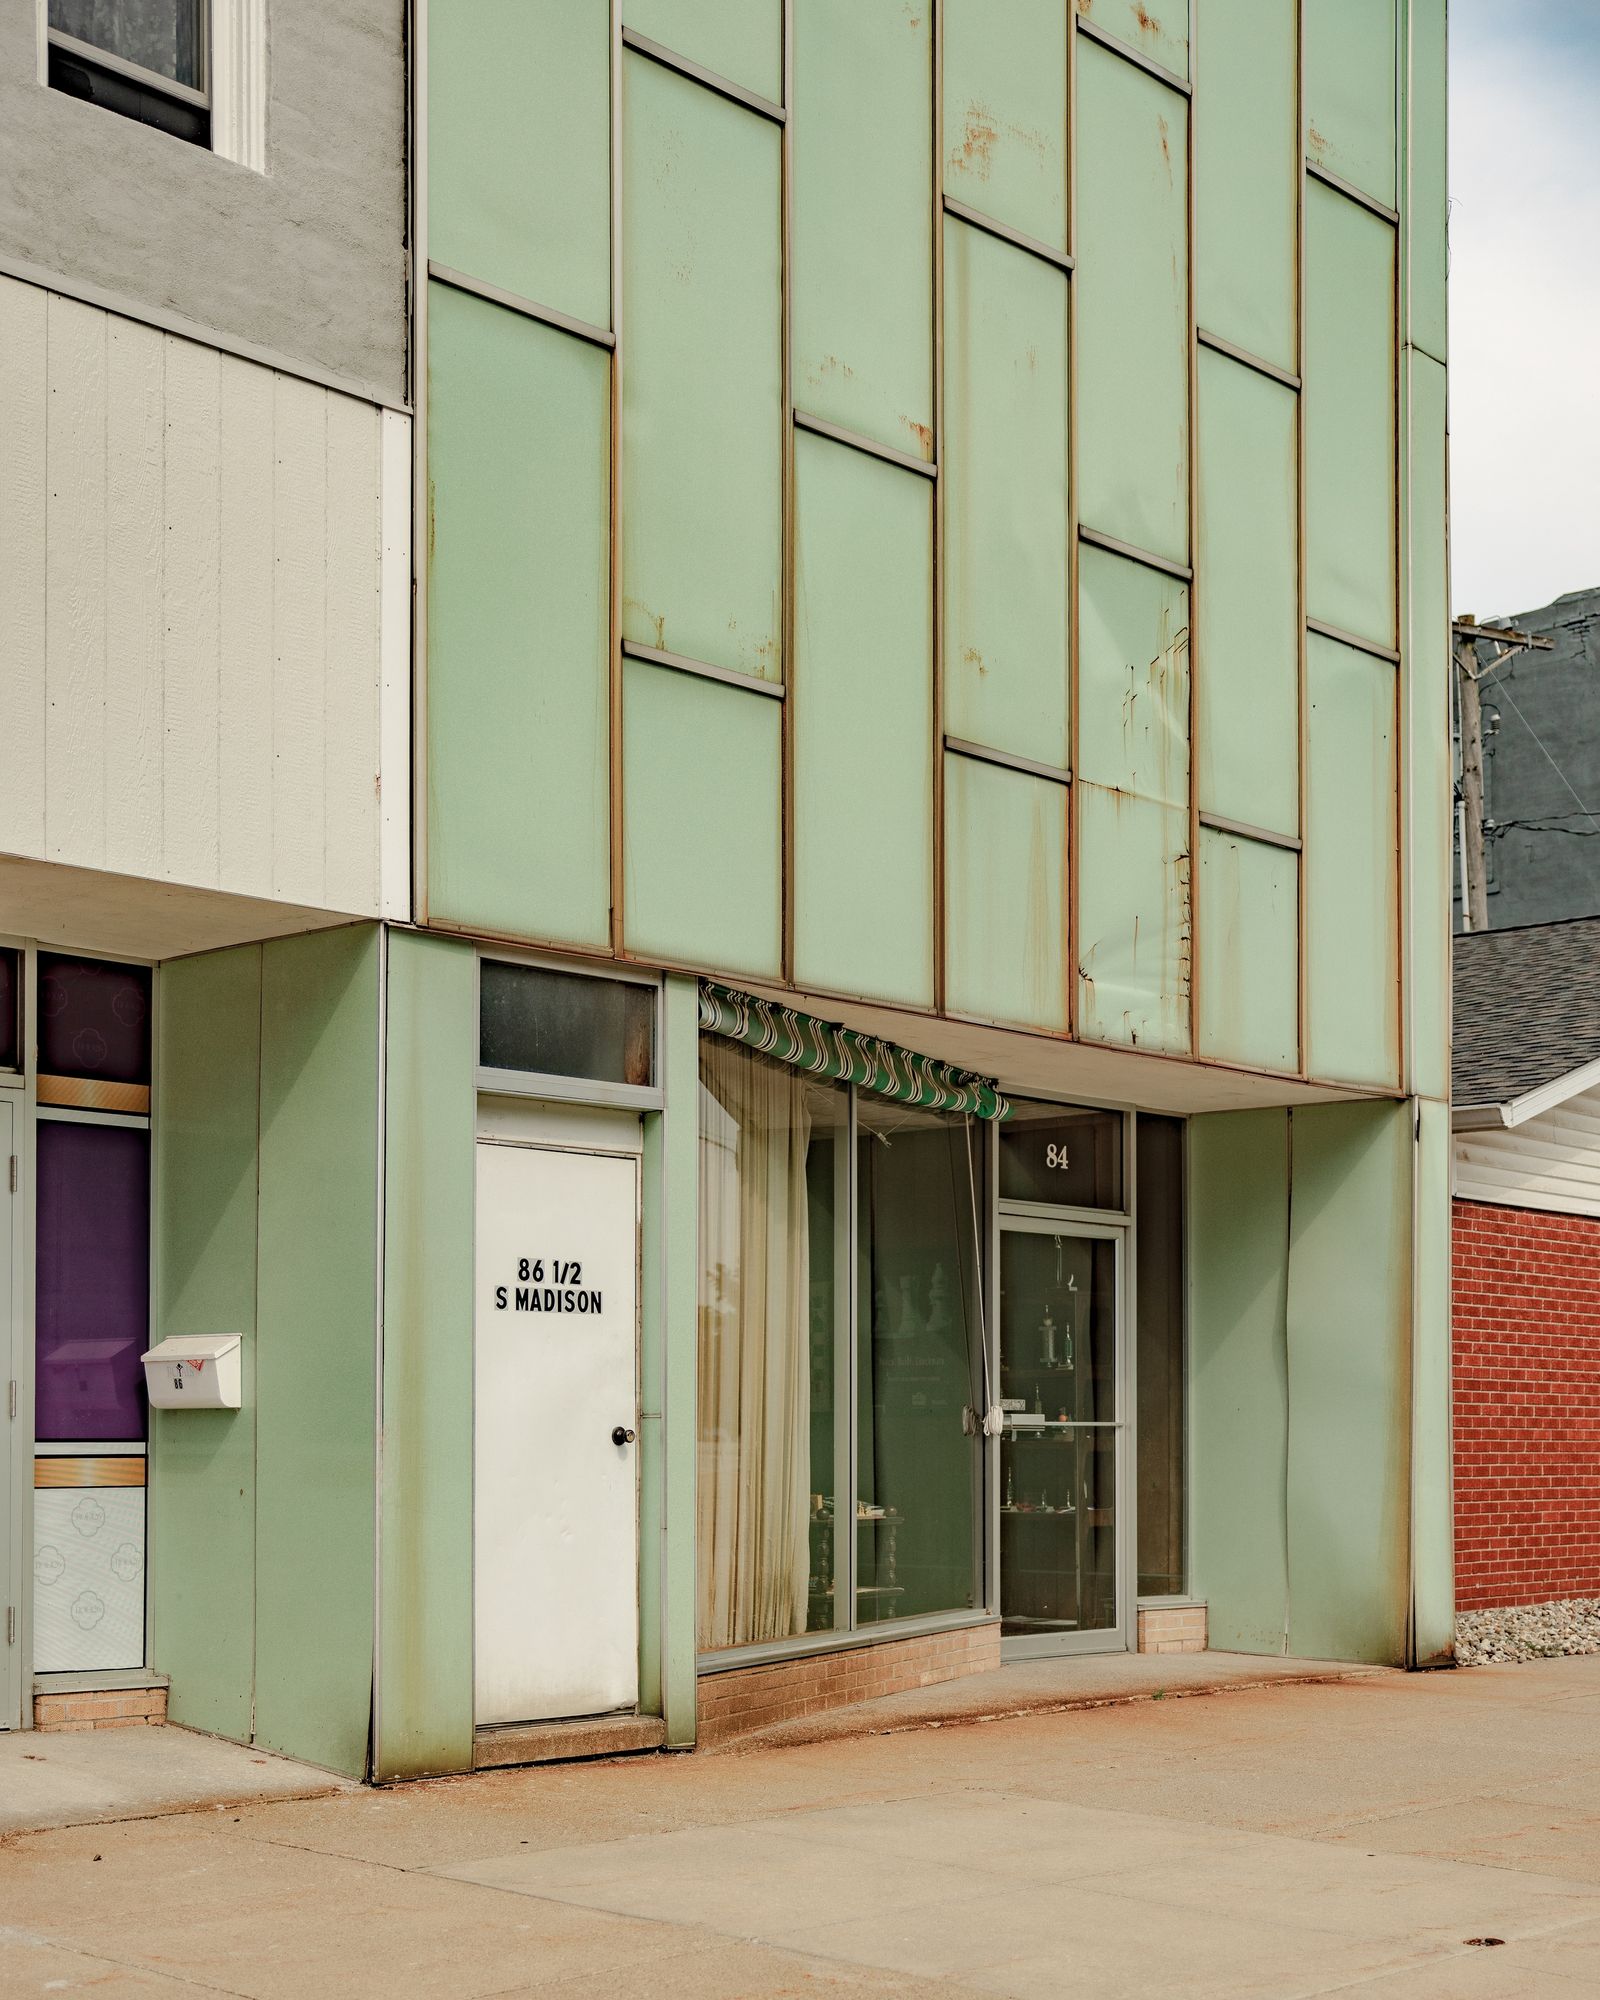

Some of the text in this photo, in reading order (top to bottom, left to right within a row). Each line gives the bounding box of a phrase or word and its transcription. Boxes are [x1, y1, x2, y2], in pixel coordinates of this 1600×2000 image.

[1046, 1143, 1069, 1169] 84
[518, 1258, 581, 1284] 86 1/2
[496, 1286, 602, 1314] S MADISON
[174, 1378, 183, 1389] 86
